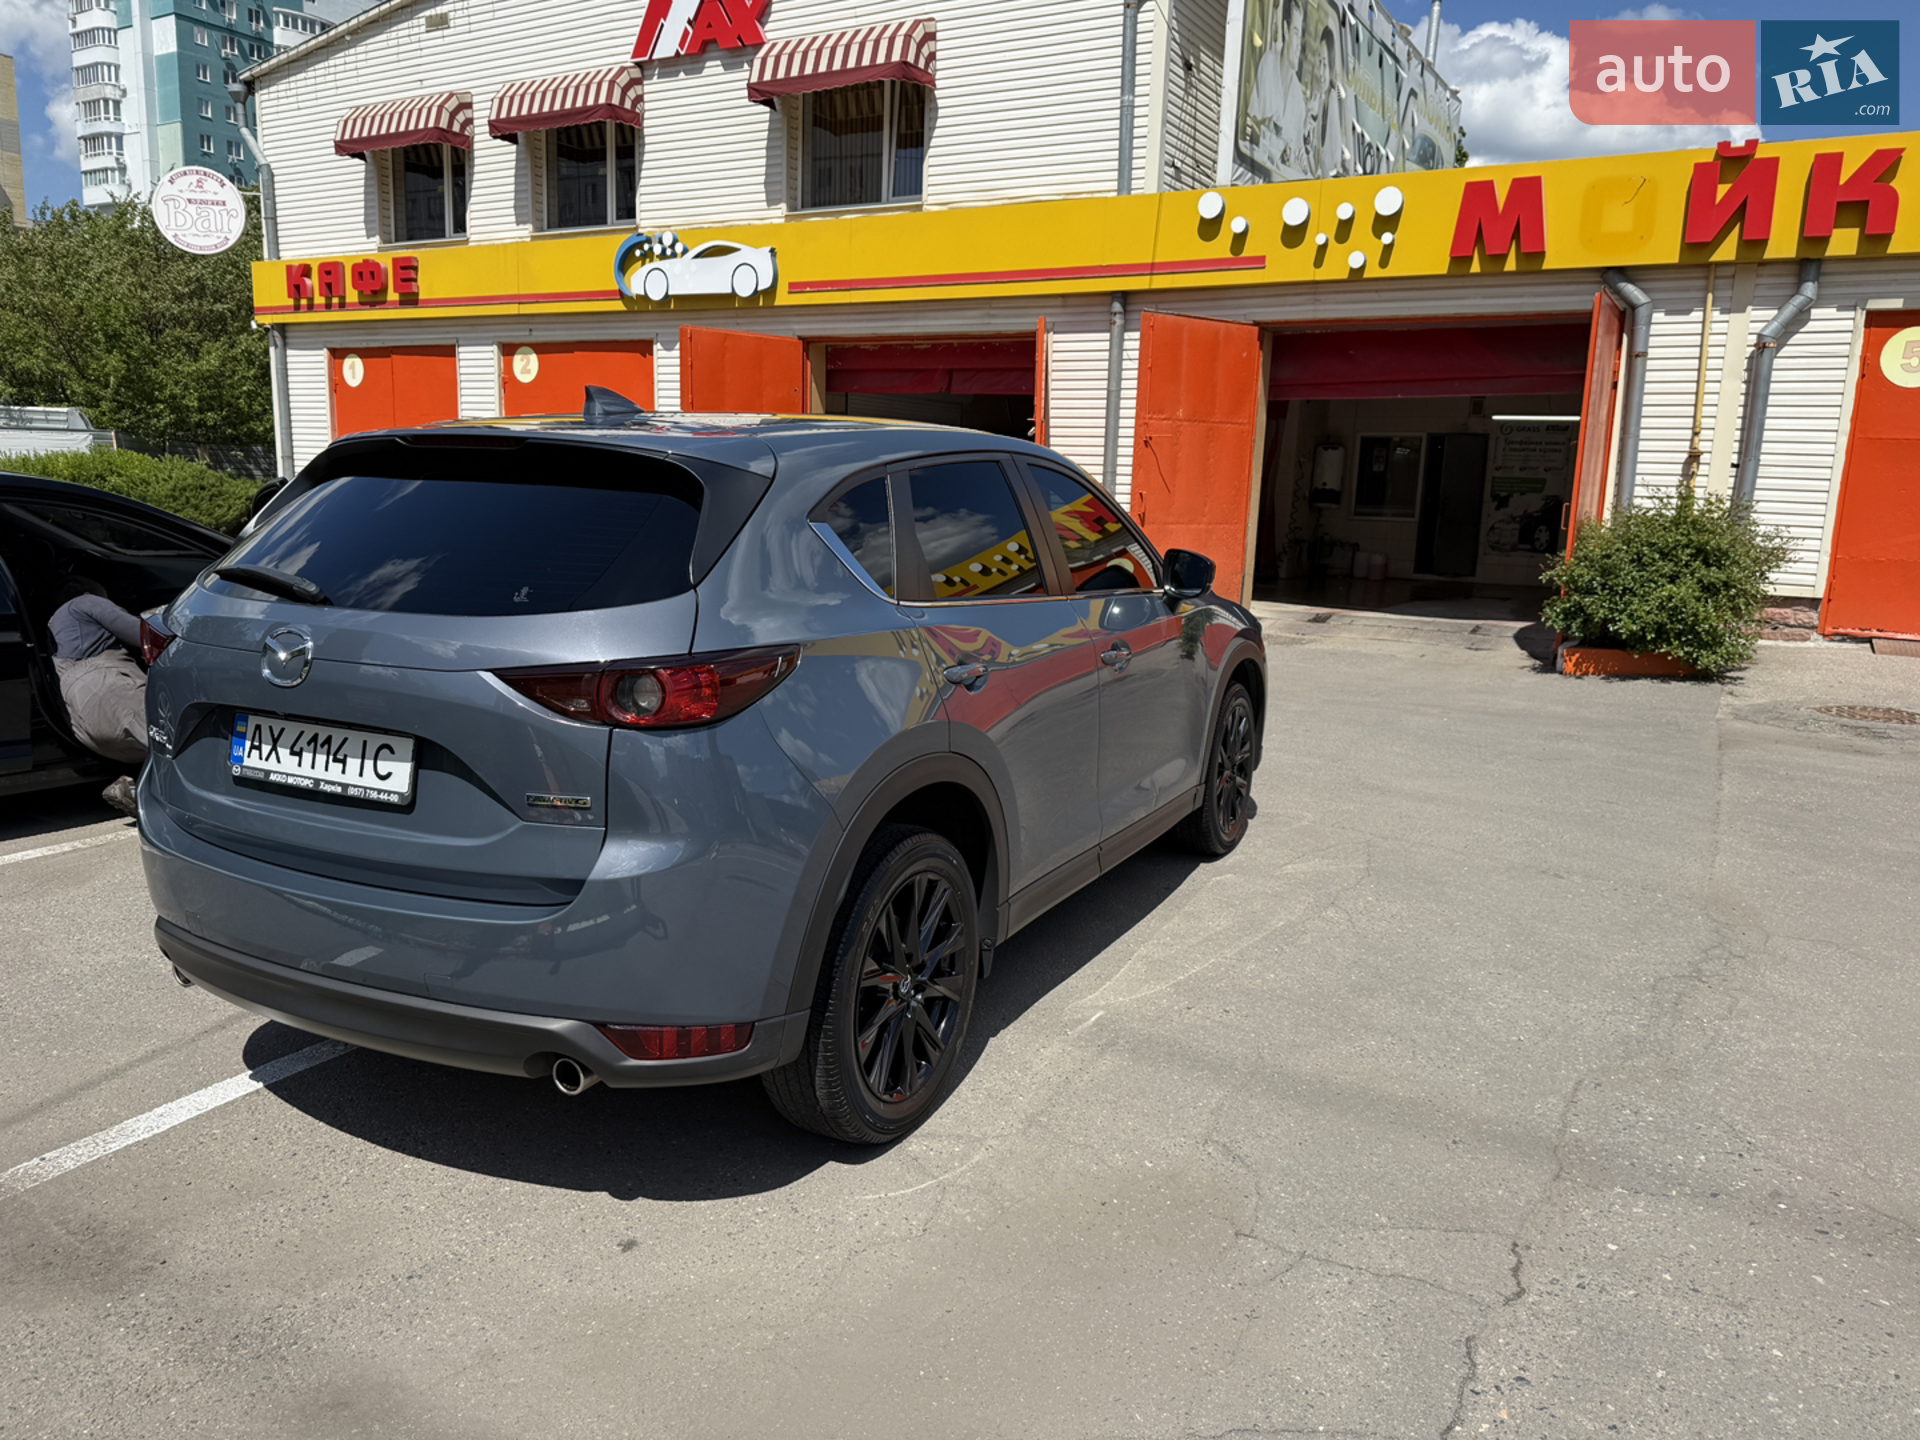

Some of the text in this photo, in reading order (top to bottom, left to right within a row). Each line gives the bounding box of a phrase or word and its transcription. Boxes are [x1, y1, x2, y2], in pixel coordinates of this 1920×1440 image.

[161, 194, 239, 234] Bar
[285, 256, 420, 300] КАФЕ
[350, 361, 357, 380] 1
[520, 355, 532, 375] 2
[1900, 340, 1920, 374] 5
[233, 746, 244, 758] UA
[247, 723, 396, 781] AX 4114 IC
[287, 775, 314, 788] МОТОРС
